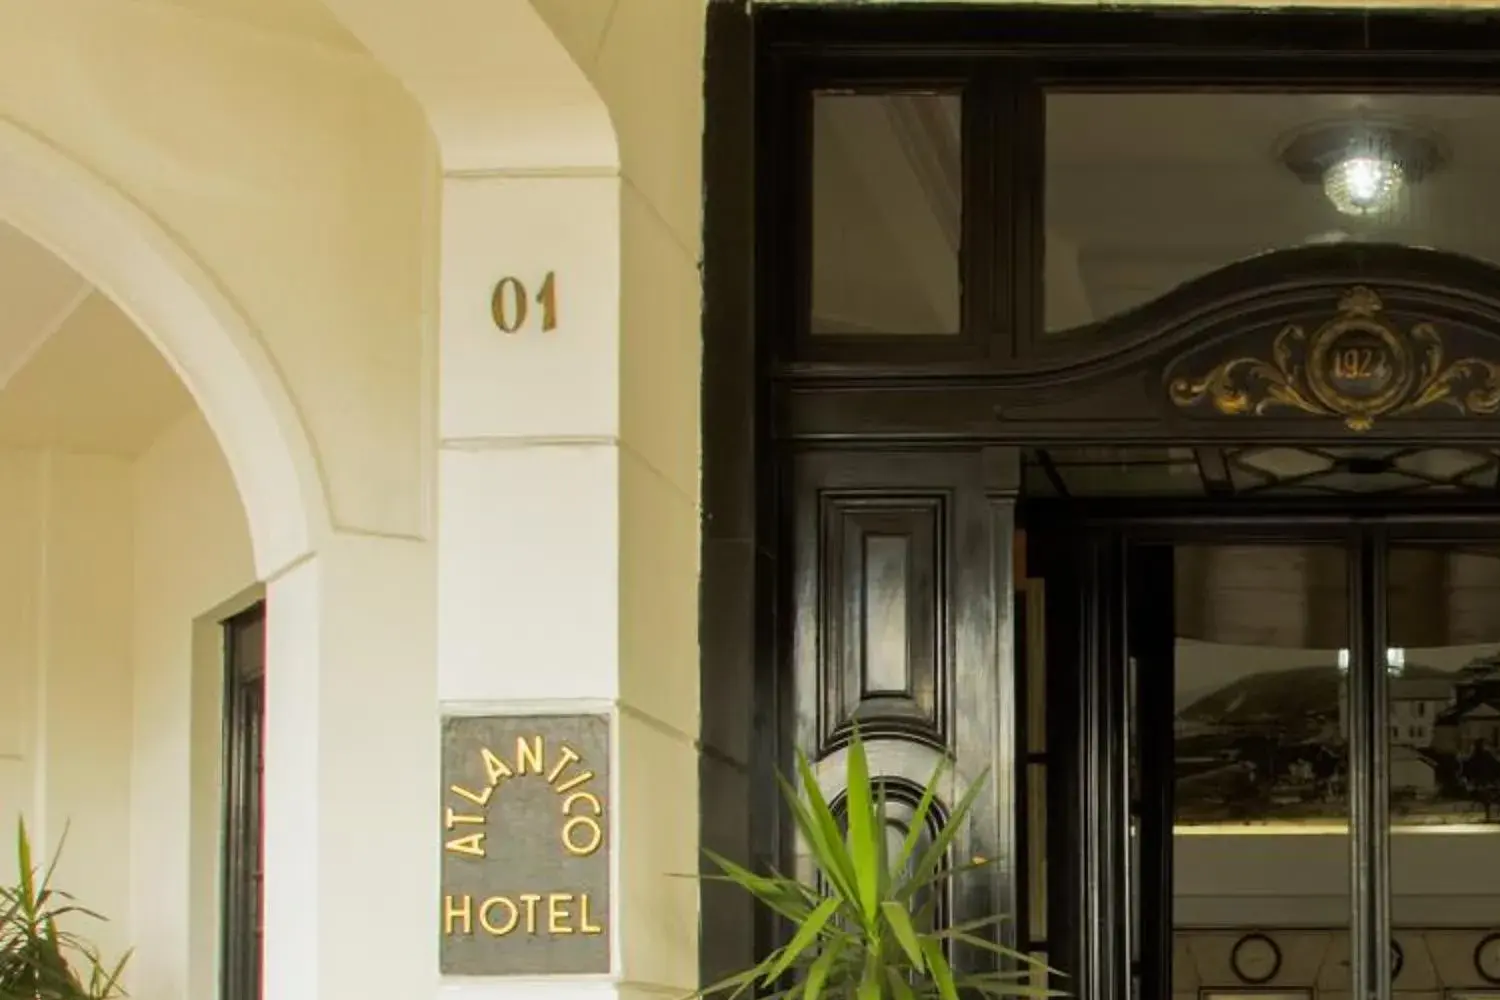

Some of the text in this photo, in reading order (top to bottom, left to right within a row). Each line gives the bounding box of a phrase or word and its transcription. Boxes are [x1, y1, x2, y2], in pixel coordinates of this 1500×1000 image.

[491, 270, 557, 333] 01
[445, 735, 602, 857] ATLANTICO
[445, 893, 602, 936] HOTEL
